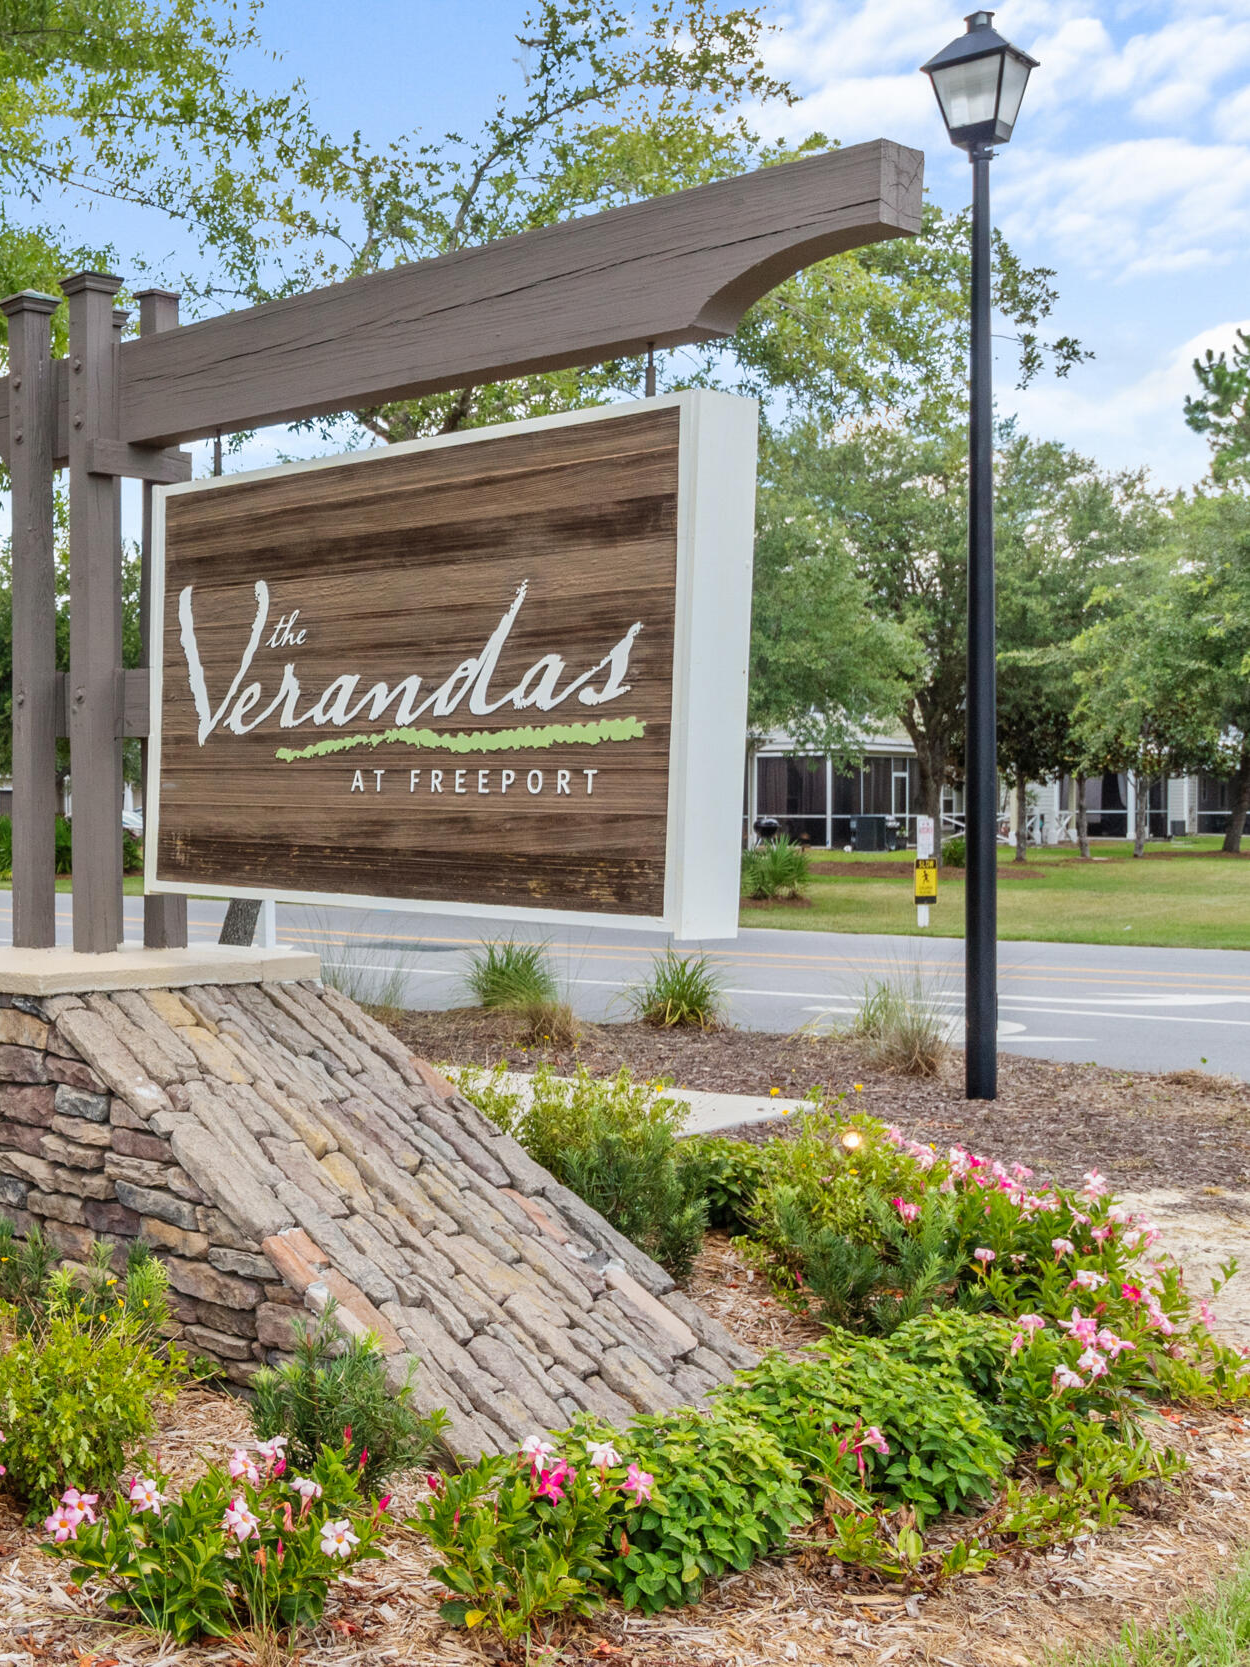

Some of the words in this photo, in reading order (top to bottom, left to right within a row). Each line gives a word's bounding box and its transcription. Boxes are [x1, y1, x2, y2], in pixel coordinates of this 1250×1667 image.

[266, 609, 307, 648] the
[179, 578, 643, 747] Verandas
[351, 769, 386, 793] AT
[411, 769, 600, 794] FREEPORT
